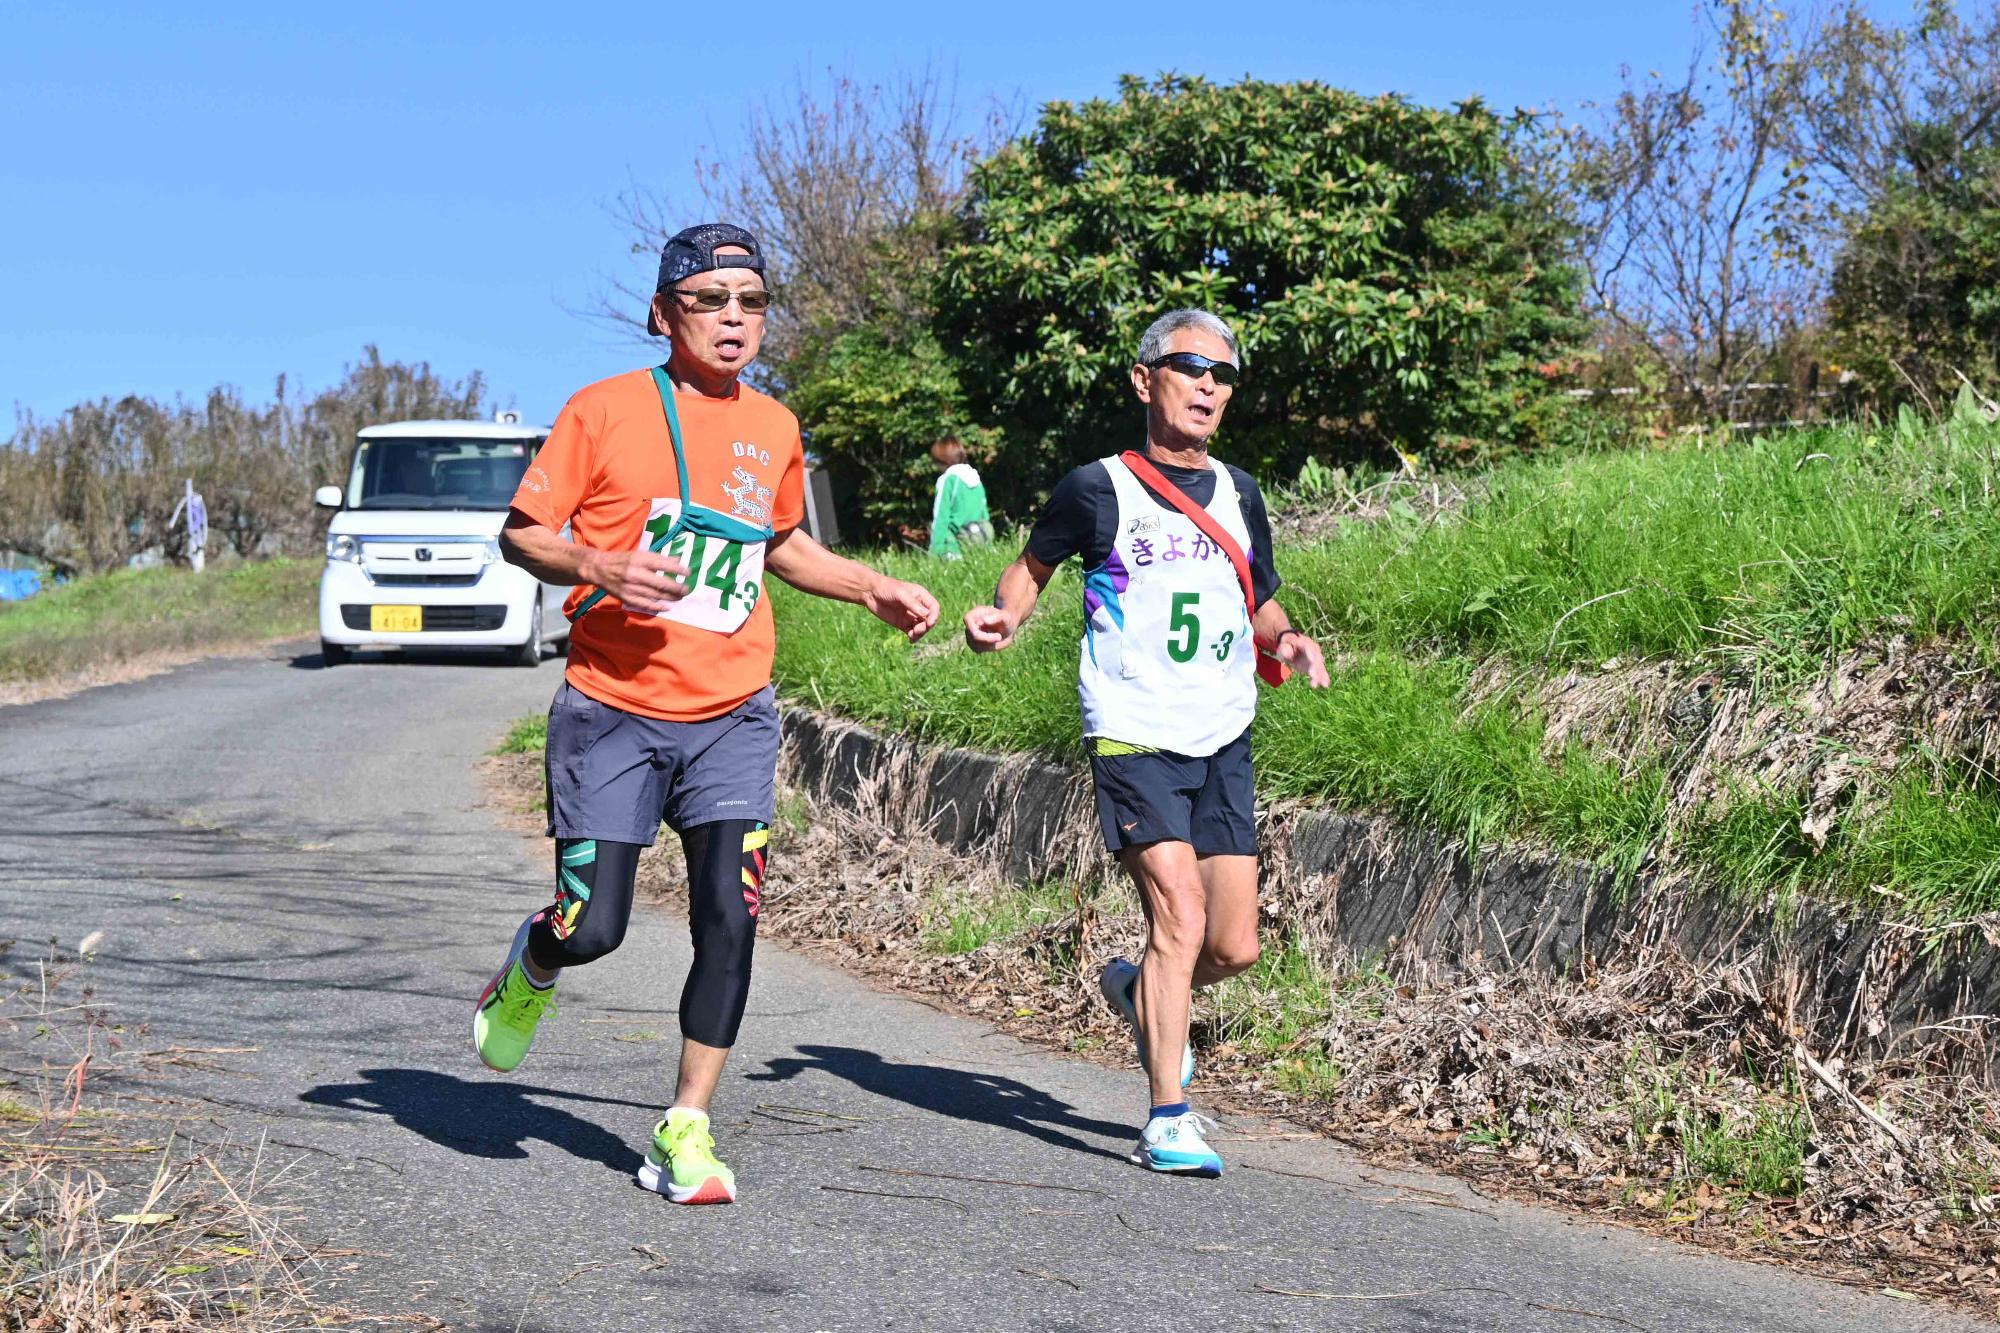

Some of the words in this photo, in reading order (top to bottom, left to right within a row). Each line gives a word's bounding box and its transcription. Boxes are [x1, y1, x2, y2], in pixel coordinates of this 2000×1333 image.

[732, 441, 770, 467] DAC
[1131, 533, 1231, 566] きよか
